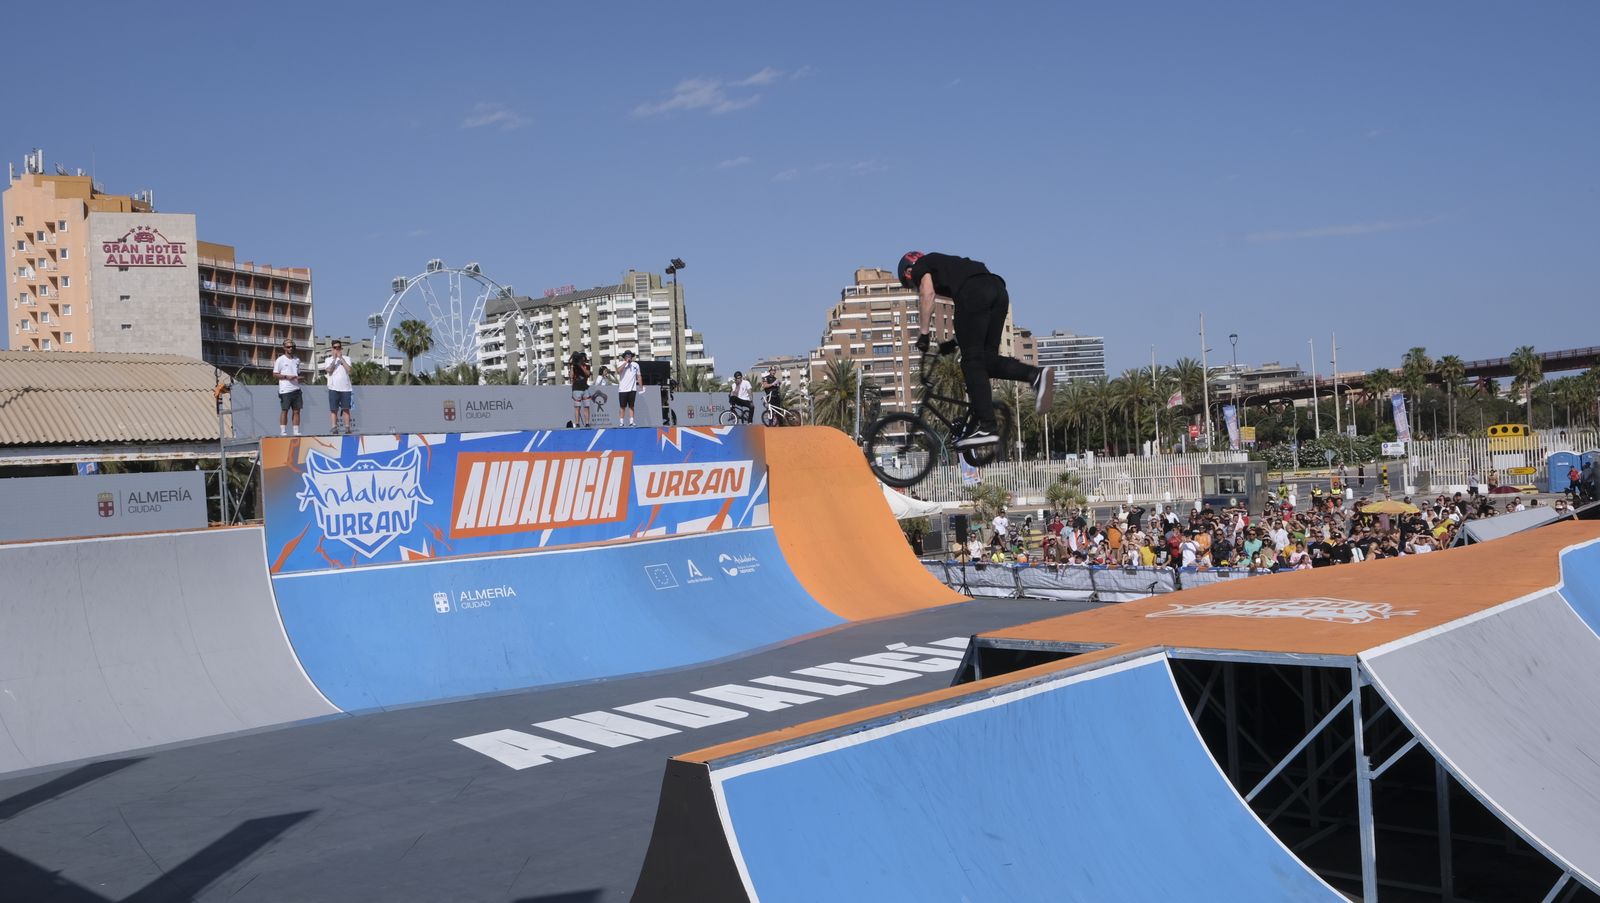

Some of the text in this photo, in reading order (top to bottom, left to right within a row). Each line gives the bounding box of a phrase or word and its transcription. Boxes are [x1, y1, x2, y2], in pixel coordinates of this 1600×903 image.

[102, 244, 187, 254] GRAN HOTEL
[106, 254, 184, 265] ALMERIA
[465, 398, 514, 411] ALMERÍA
[465, 411, 491, 419] CIUDAD
[455, 450, 625, 530] ANDALUCÍA
[645, 467, 745, 498] URBAN
[128, 487, 193, 504] ALMERÍA
[299, 472, 431, 509] Andalucía
[128, 504, 162, 514] CIUDAD
[326, 509, 410, 537] URBAN
[460, 585, 517, 602] ALMERÍA
[461, 600, 491, 609] CIUDAD
